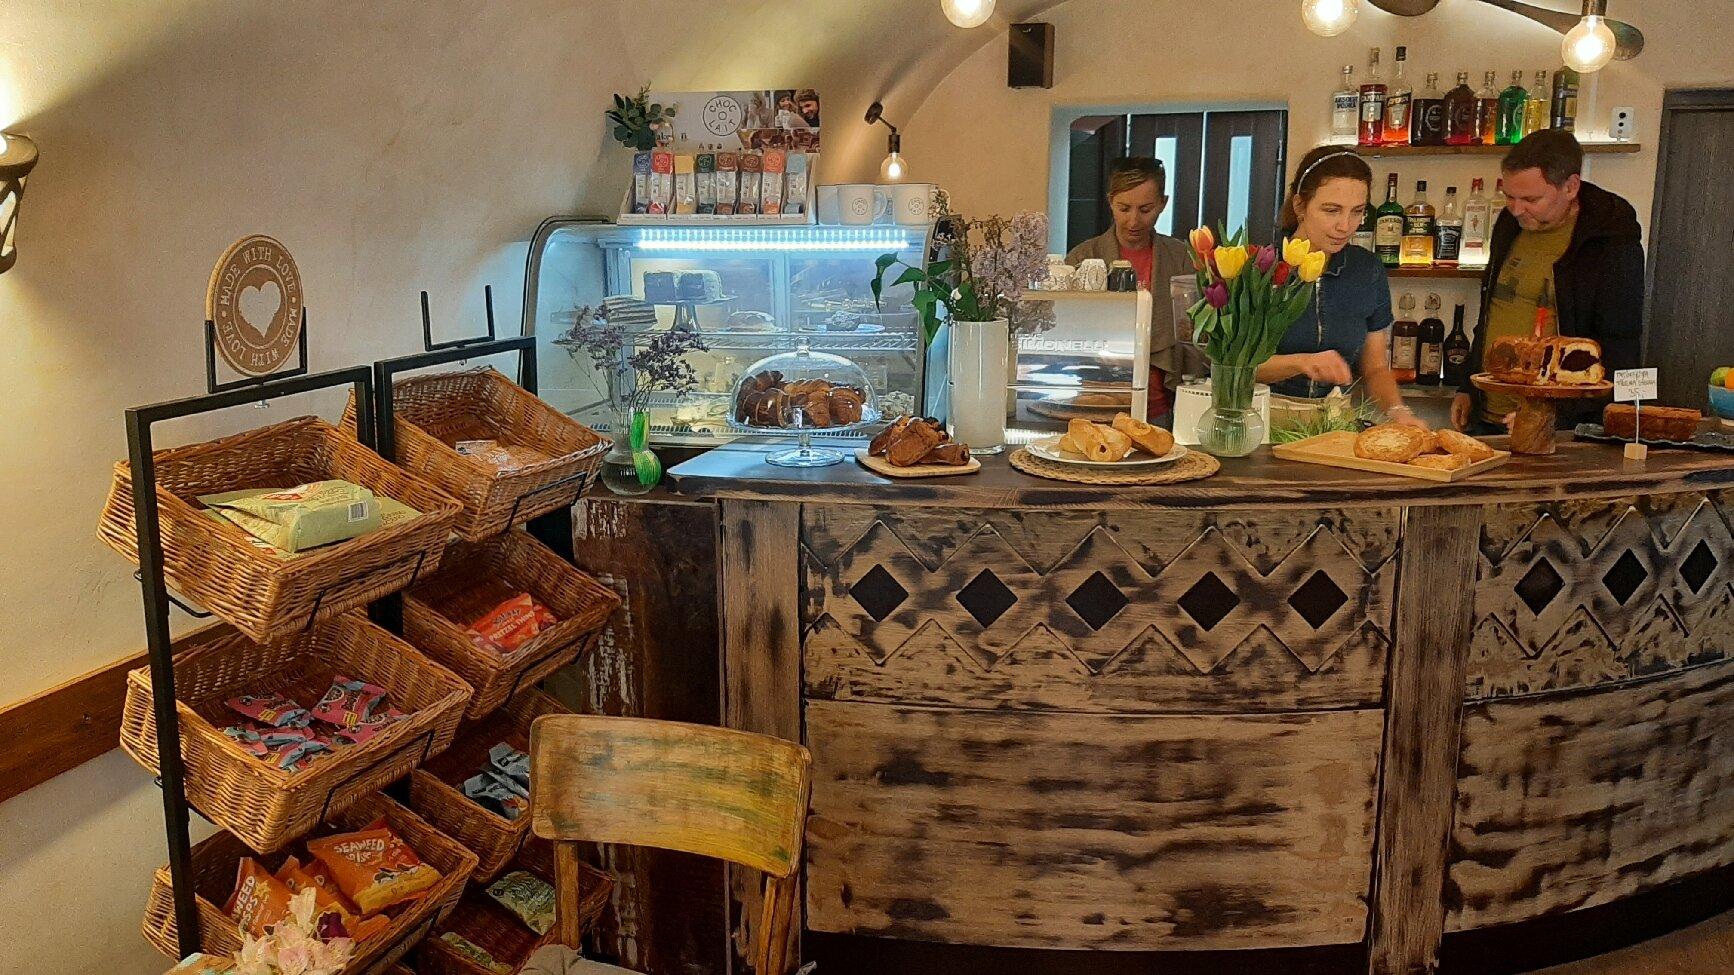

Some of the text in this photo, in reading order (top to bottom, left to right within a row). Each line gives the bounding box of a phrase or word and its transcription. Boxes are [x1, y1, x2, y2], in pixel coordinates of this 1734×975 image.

[709, 99, 737, 113] CHOC
[708, 119, 736, 133] LAIT
[220, 246, 296, 306] MADE WITH LOVE
[222, 308, 298, 366] MADE WITH LOVE
[488, 623, 518, 642] PRETZEL
[334, 838, 385, 853] SEAWEED
